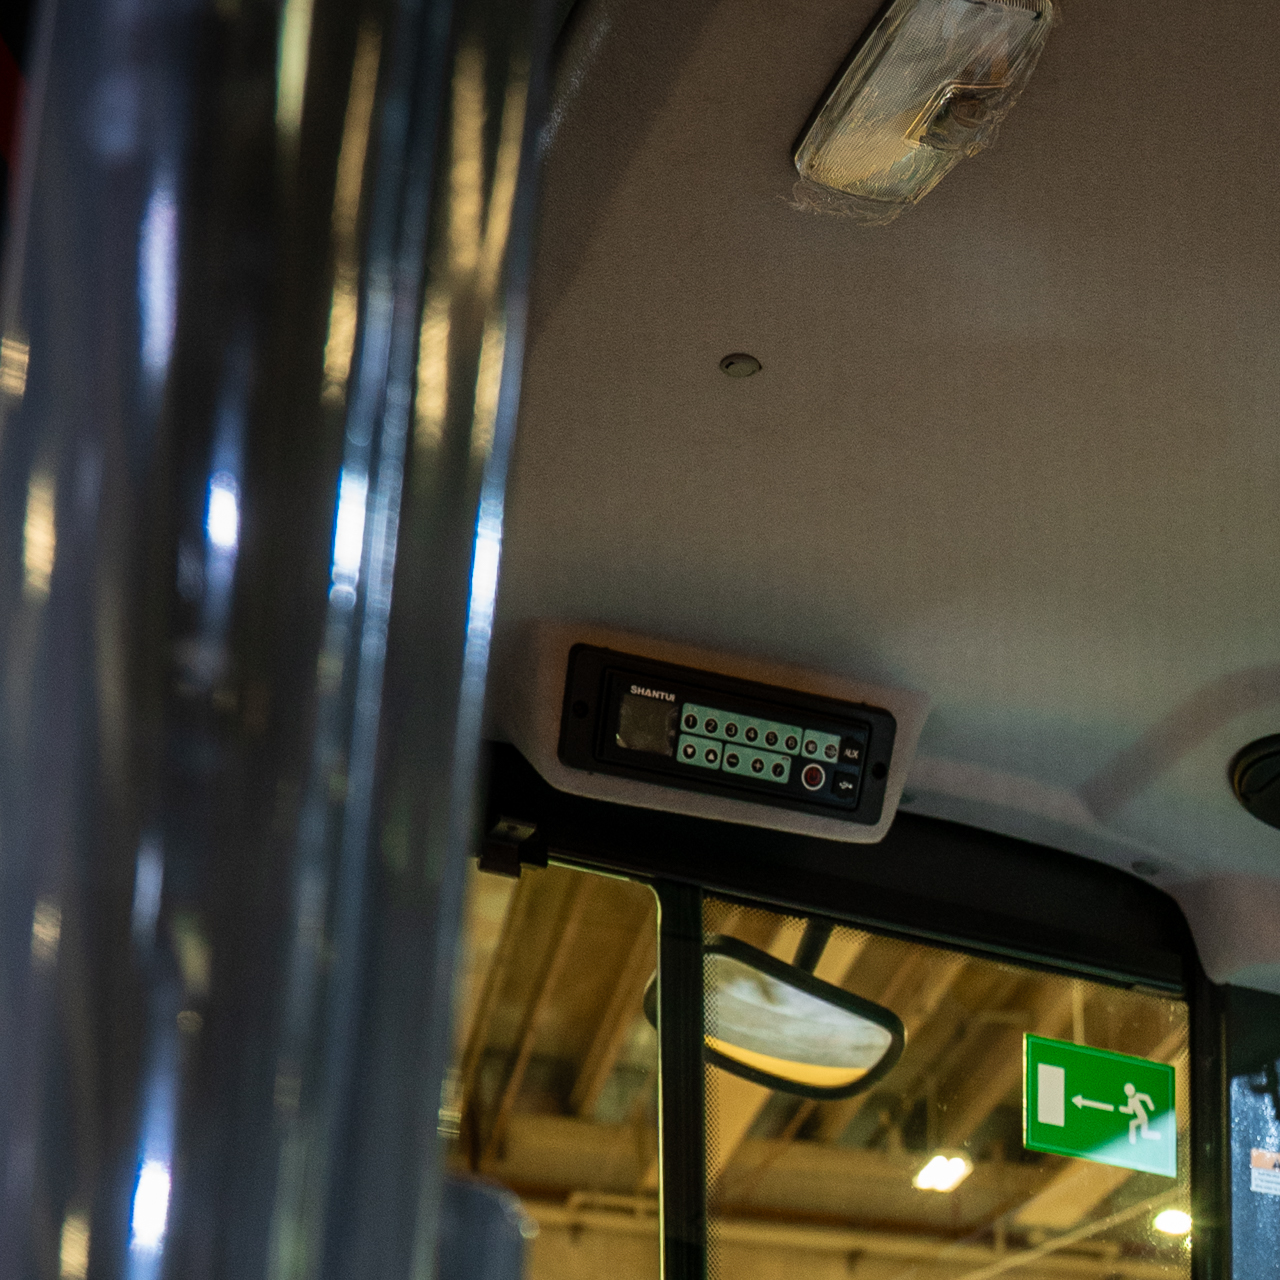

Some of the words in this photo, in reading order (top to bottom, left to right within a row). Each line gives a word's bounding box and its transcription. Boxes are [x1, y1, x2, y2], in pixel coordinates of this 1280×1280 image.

[630, 685, 676, 702] SHANTUI
[706, 719, 717, 733] 2
[727, 723, 737, 737] 3
[747, 727, 757, 742] 4
[767, 732, 776, 746] 5
[787, 736, 796, 750] 6
